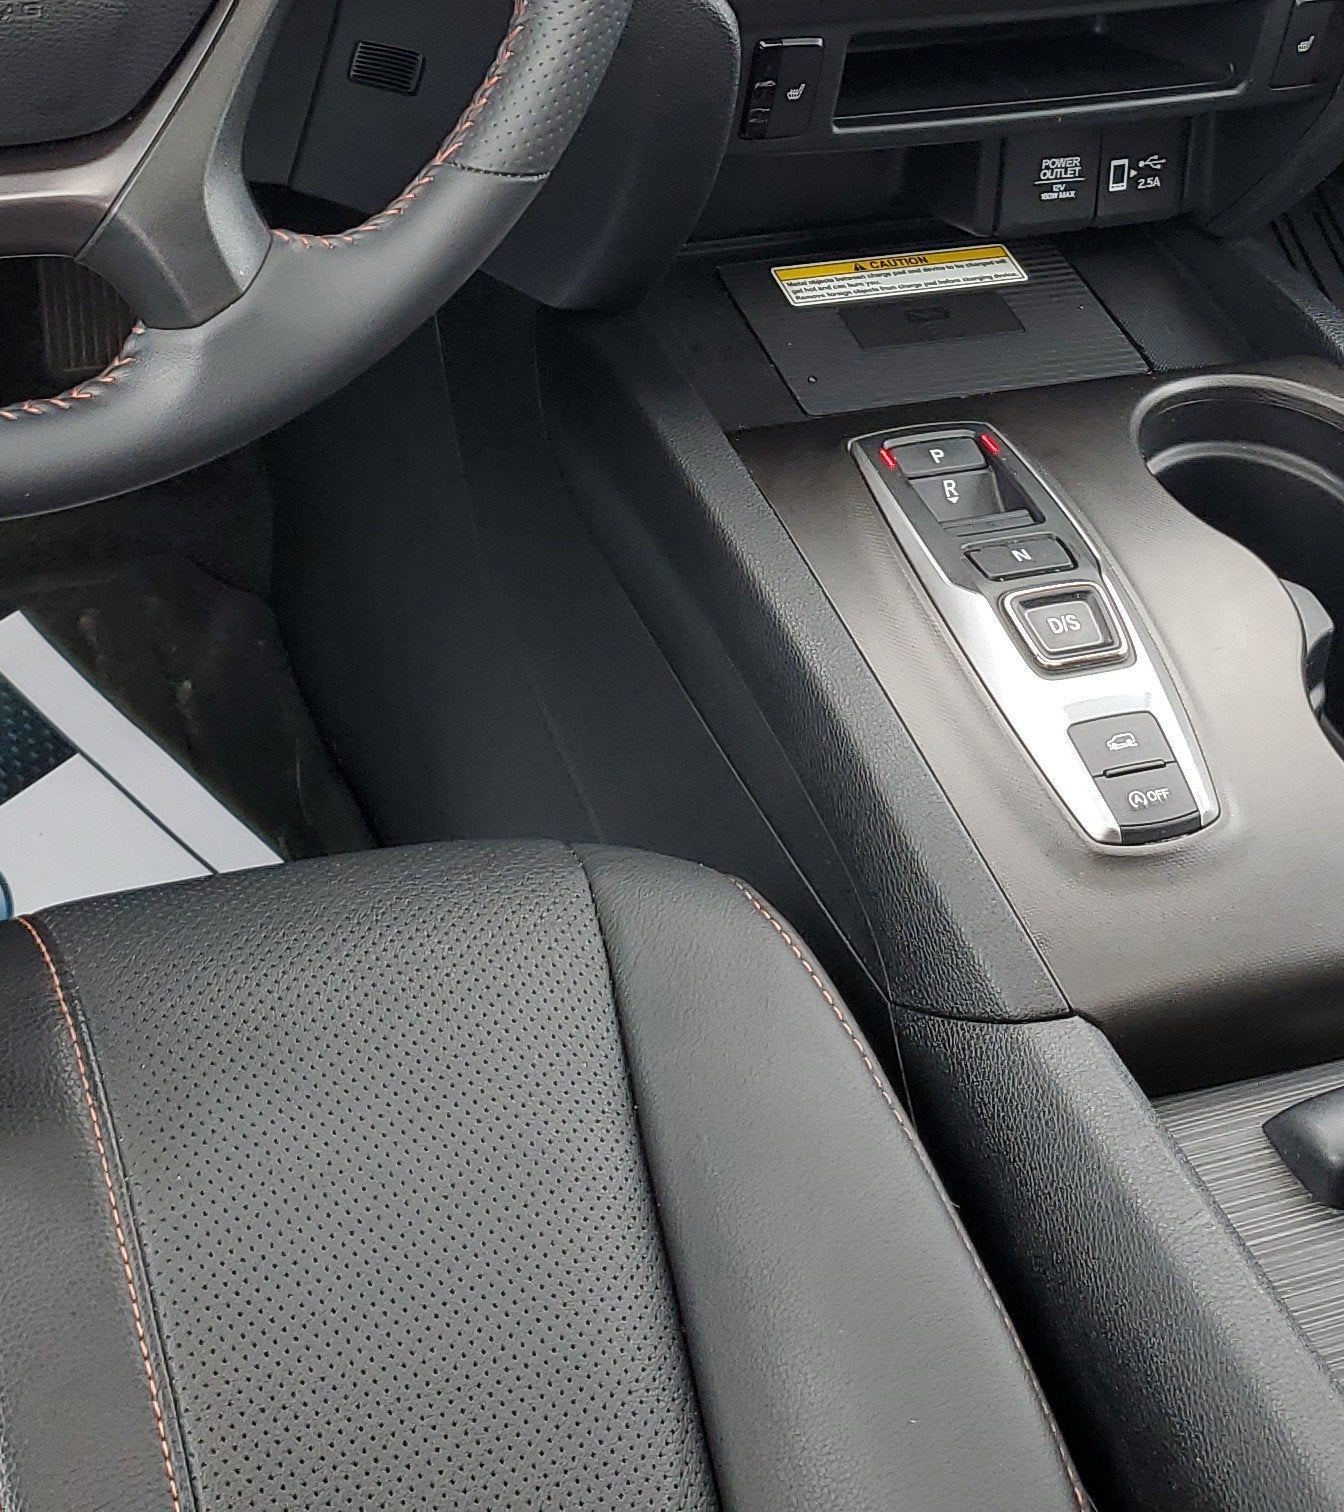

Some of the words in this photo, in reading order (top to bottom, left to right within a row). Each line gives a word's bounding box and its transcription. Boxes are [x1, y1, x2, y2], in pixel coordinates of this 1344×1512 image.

[1041, 157, 1081, 169] POWER
[1040, 167, 1082, 179] OUTLET
[1137, 177, 1161, 189] 2.5A
[869, 256, 930, 270] CAUTION
[929, 449, 944, 464] P
[942, 479, 958, 498] R
[1011, 547, 1032, 563] N
[1047, 614, 1081, 634] D/S
[1147, 788, 1170, 803] OFF
